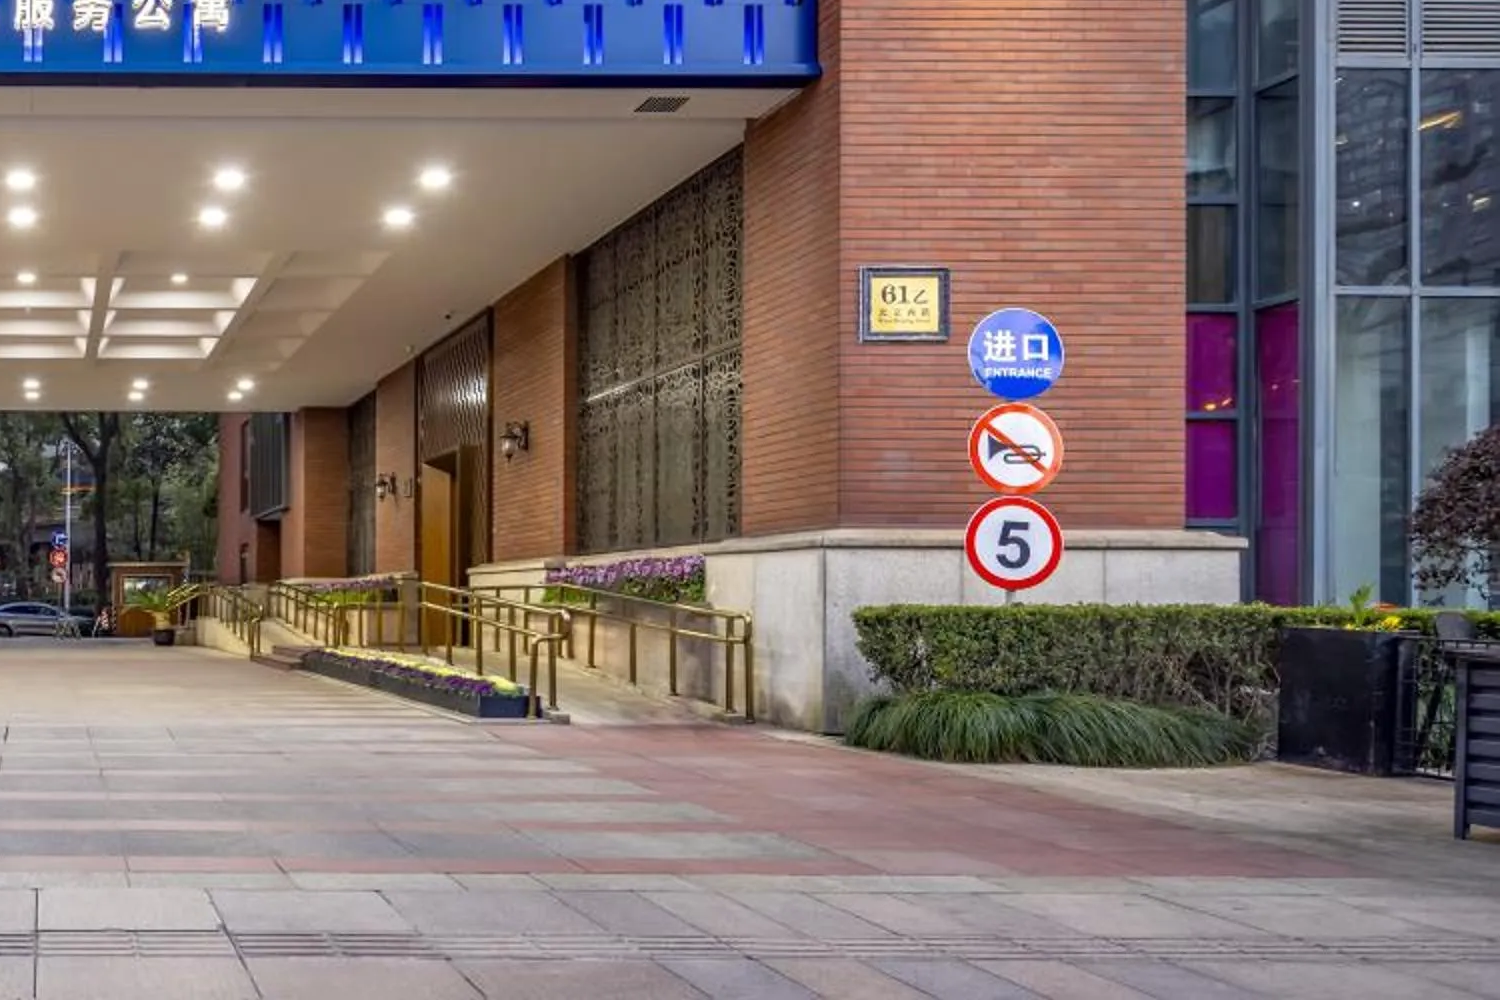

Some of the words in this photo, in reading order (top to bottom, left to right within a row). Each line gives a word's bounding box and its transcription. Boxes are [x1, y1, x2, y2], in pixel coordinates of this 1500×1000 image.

[983, 328, 1049, 362] 进口
[983, 367, 1052, 380] ENTRANCE
[996, 520, 1031, 569] 5
